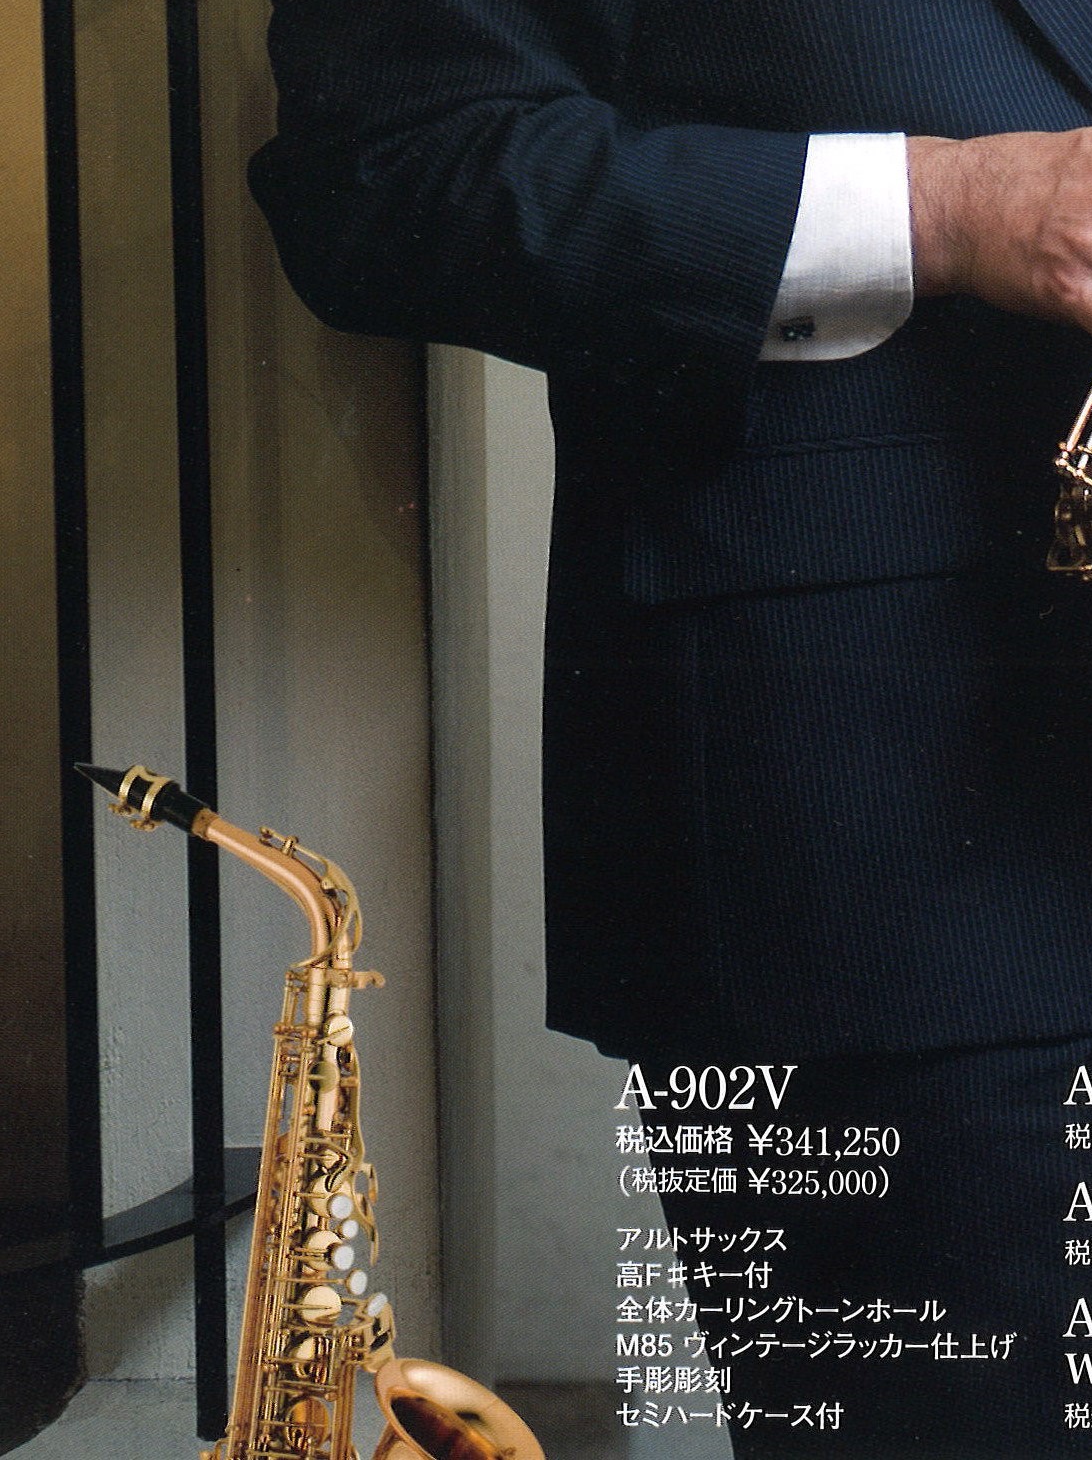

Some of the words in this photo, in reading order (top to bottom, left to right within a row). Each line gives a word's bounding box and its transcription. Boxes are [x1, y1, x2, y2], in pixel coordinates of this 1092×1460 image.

[613, 1063, 798, 1110] A-902V
[615, 1124, 733, 1154] 税込価格
[747, 1124, 900, 1162] ¥341,250
[619, 1165, 737, 1197] (税抜定価
[747, 1165, 889, 1199] ¥325,000)
[616, 1227, 787, 1253] アルトサックス
[616, 1295, 947, 1324] 全体カーリングトーンホール
[616, 1333, 673, 1357] M85
[684, 1330, 1014, 1360] ヴィンテージラッカー仕上げ
[616, 1365, 731, 1394] 手彫彫刻
[616, 1401, 844, 1430] セミハードケース付
